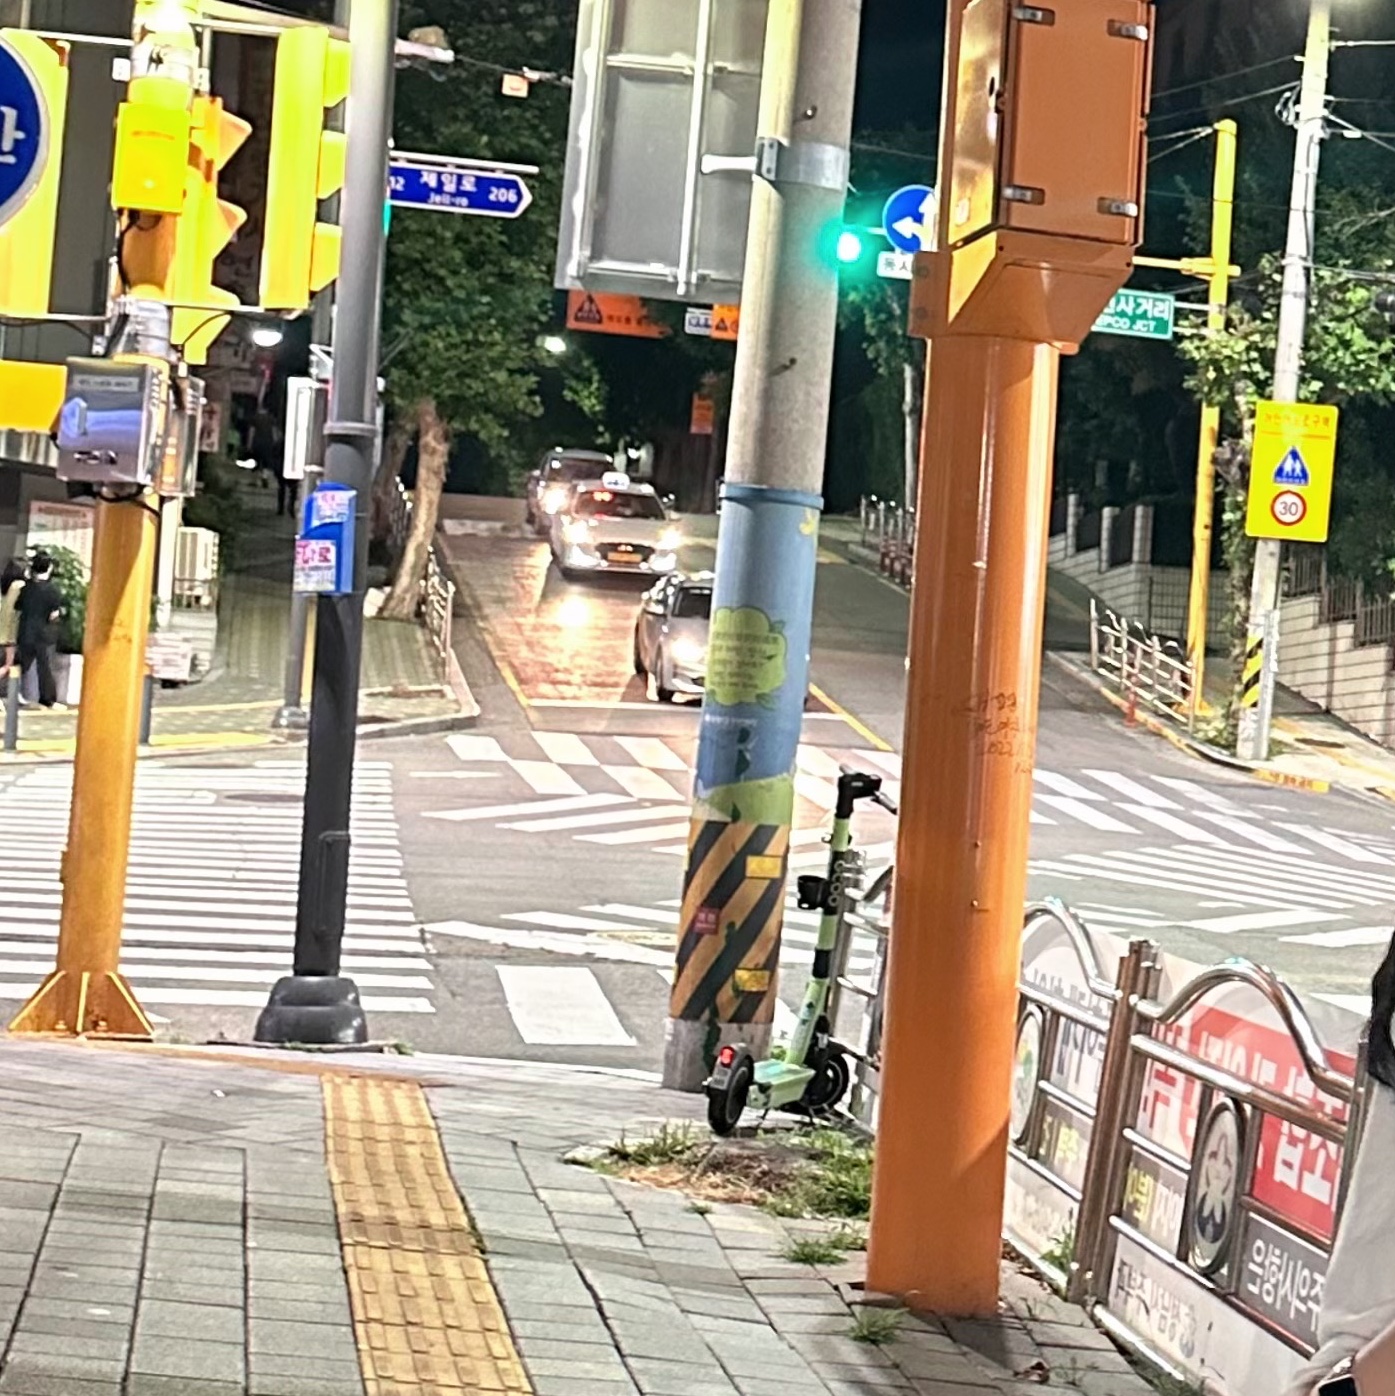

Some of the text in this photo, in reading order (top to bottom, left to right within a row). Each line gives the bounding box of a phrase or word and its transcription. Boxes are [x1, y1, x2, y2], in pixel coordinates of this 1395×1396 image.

[420, 171, 477, 192] 제일로
[488, 187, 519, 203] 206
[1279, 501, 1299, 517] 30
